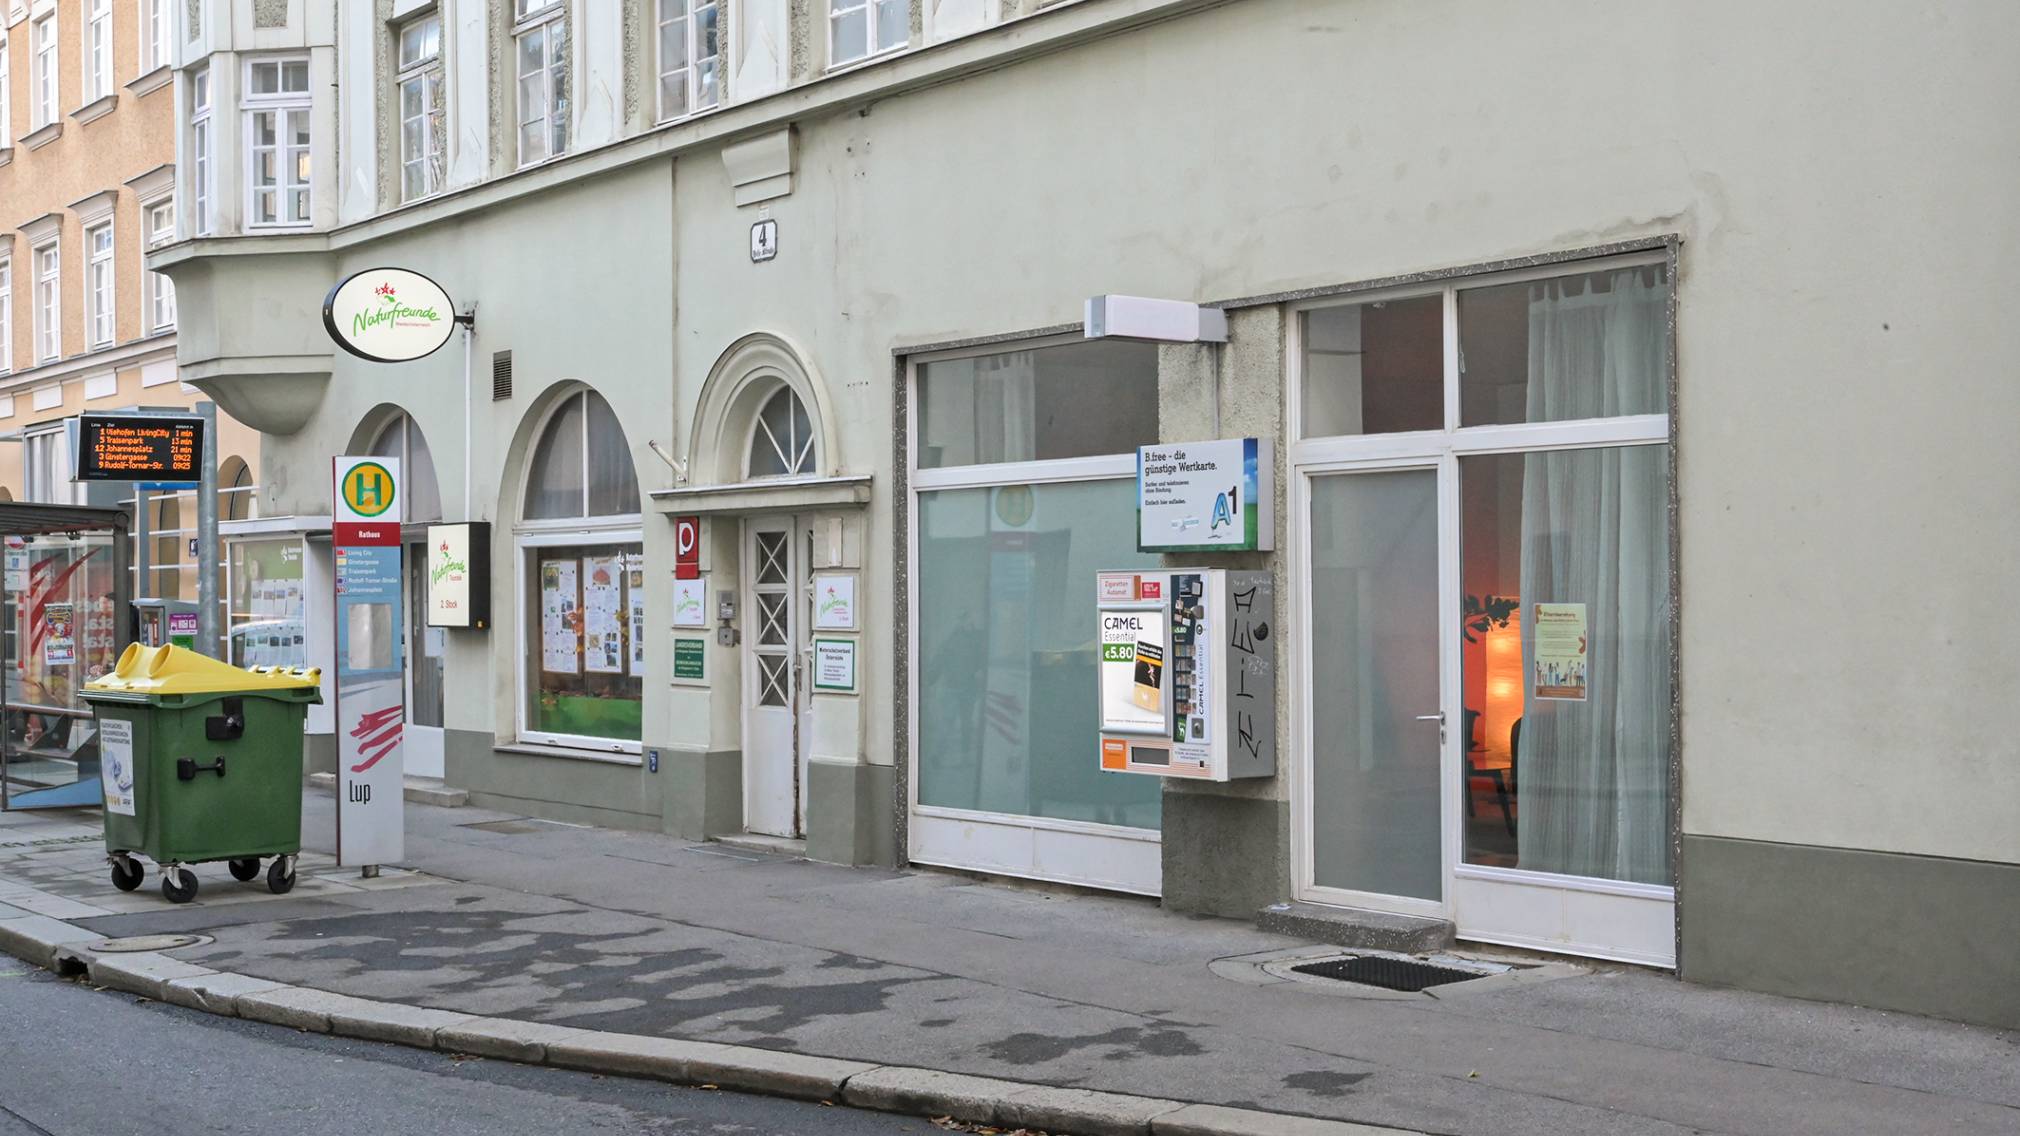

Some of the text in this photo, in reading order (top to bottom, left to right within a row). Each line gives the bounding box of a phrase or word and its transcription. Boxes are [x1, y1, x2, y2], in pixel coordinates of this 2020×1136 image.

[758, 224, 767, 247] 4
[353, 302, 440, 337] Naturfreunde
[106, 428, 135, 436] Viehofen
[137, 428, 170, 439] LivingCity
[181, 430, 194, 438] min
[105, 437, 144, 446] Traisenpark
[171, 438, 180, 446] 13
[181, 438, 193, 446] min
[95, 445, 193, 455] 12 Johannesplatz 21 min
[1145, 452, 1167, 463] B.free
[1174, 450, 1187, 461] die
[99, 453, 104, 461] 3
[104, 453, 148, 462] Ginstergasse
[99, 461, 104, 469] 9
[1145, 461, 1217, 477] günstige Wertkarte.
[356, 473, 382, 506] H
[358, 530, 381, 539] Rathaus
[1104, 617, 1143, 631] CAMEL
[1104, 632, 1136, 642] Essential
[1105, 646, 1133, 660] €5.80
[350, 780, 371, 805] Lup
